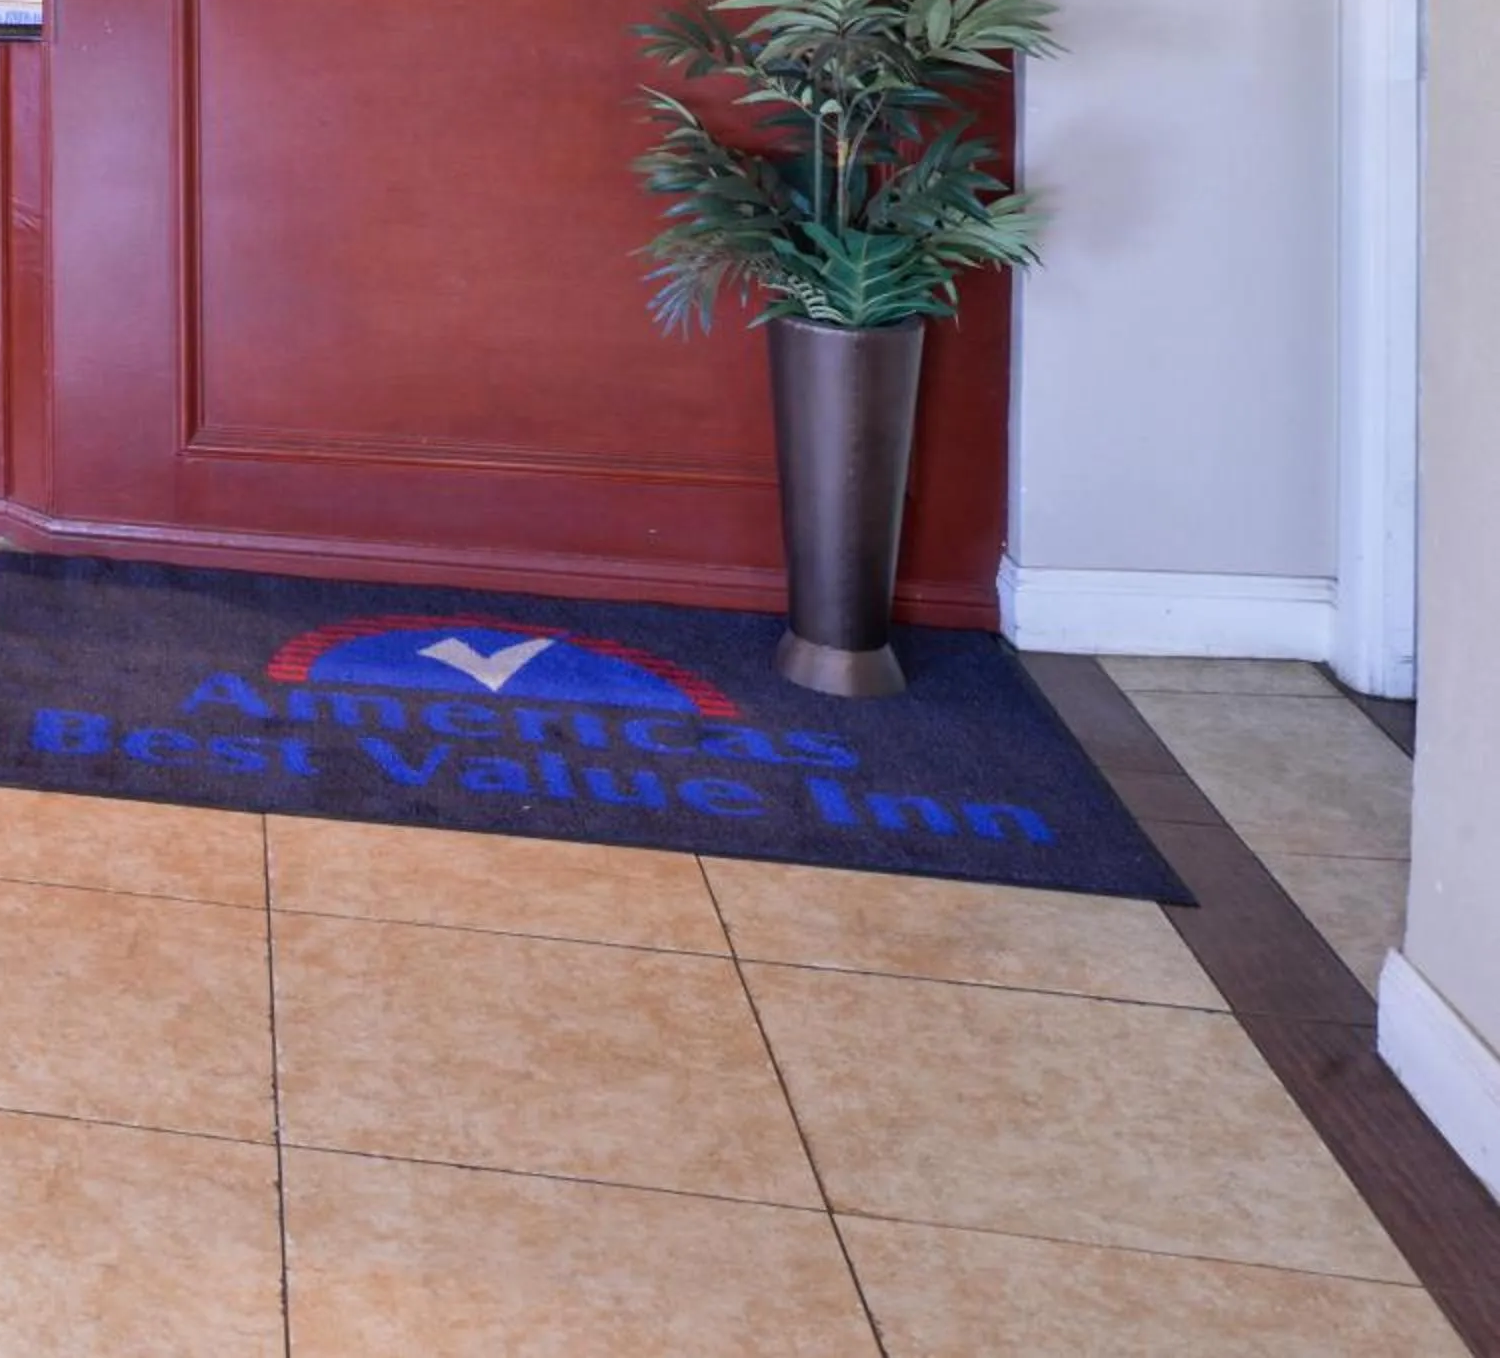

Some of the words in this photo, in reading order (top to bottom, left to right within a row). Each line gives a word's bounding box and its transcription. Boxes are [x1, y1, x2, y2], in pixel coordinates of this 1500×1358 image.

[30, 707, 320, 777] Best
[358, 736, 766, 819] Value
[804, 775, 1058, 847] Inn
[182, 672, 860, 770] Americas
